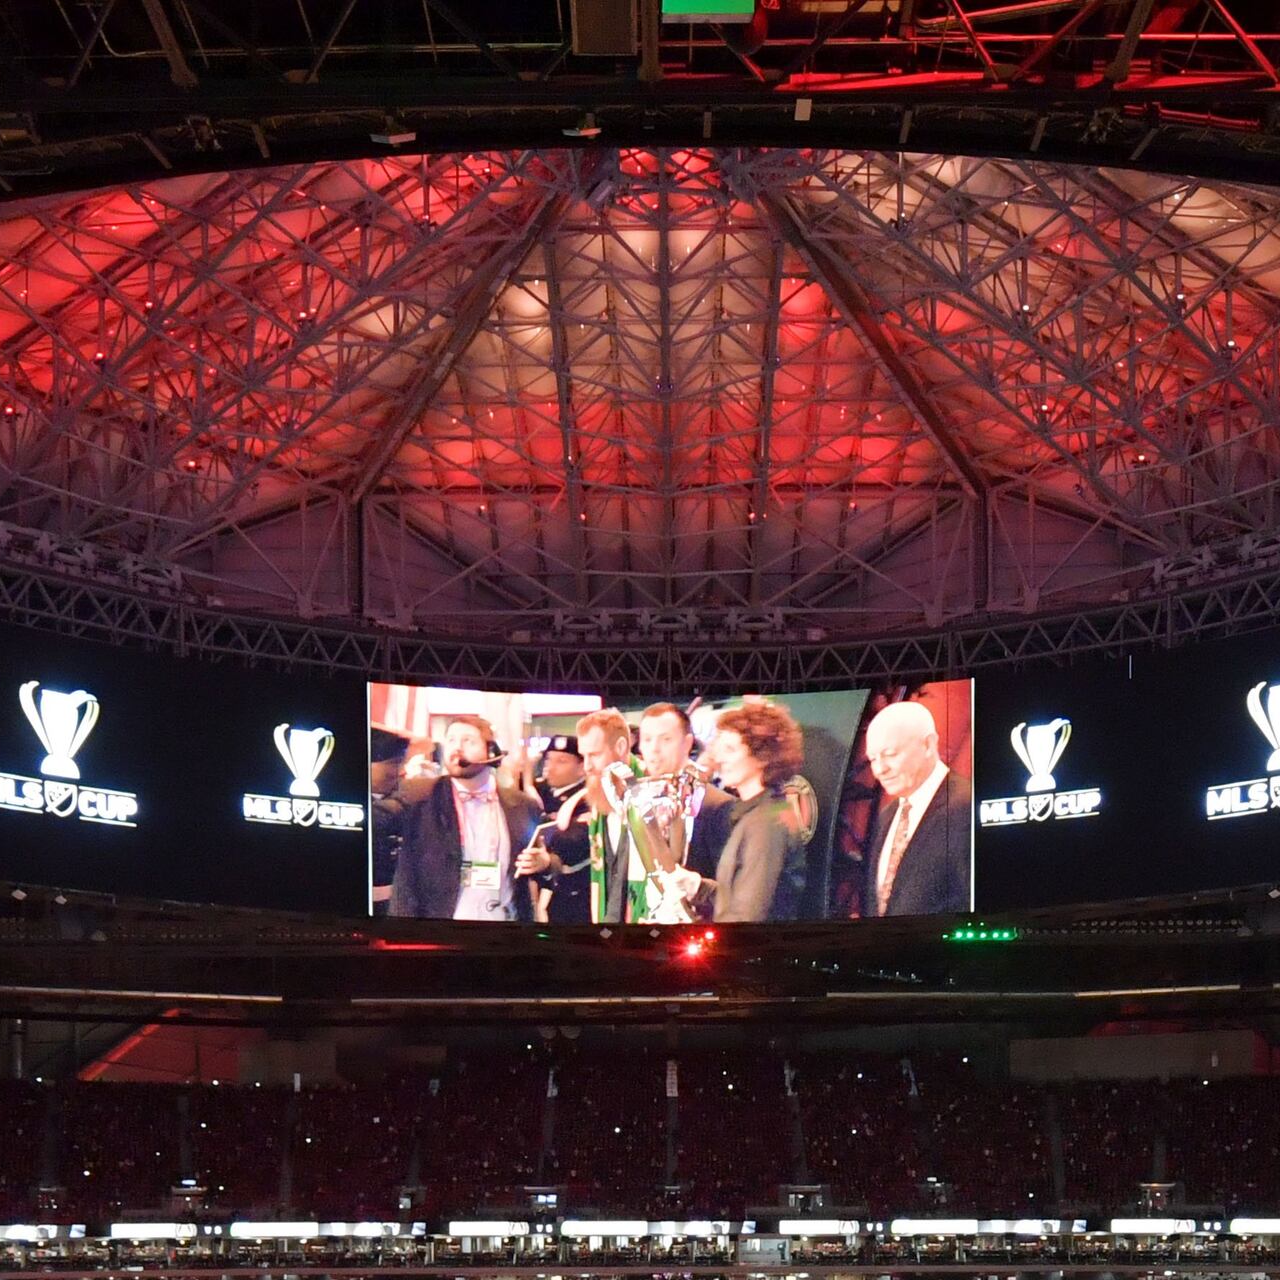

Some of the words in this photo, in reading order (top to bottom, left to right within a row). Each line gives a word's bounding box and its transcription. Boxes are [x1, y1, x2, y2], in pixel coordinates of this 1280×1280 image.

[78, 790, 138, 821] CUP
[243, 796, 292, 821] MLS
[318, 804, 364, 827] CUP
[980, 800, 1028, 823] MLS
[1054, 791, 1101, 816] CUP
[1207, 779, 1269, 816] MLS
